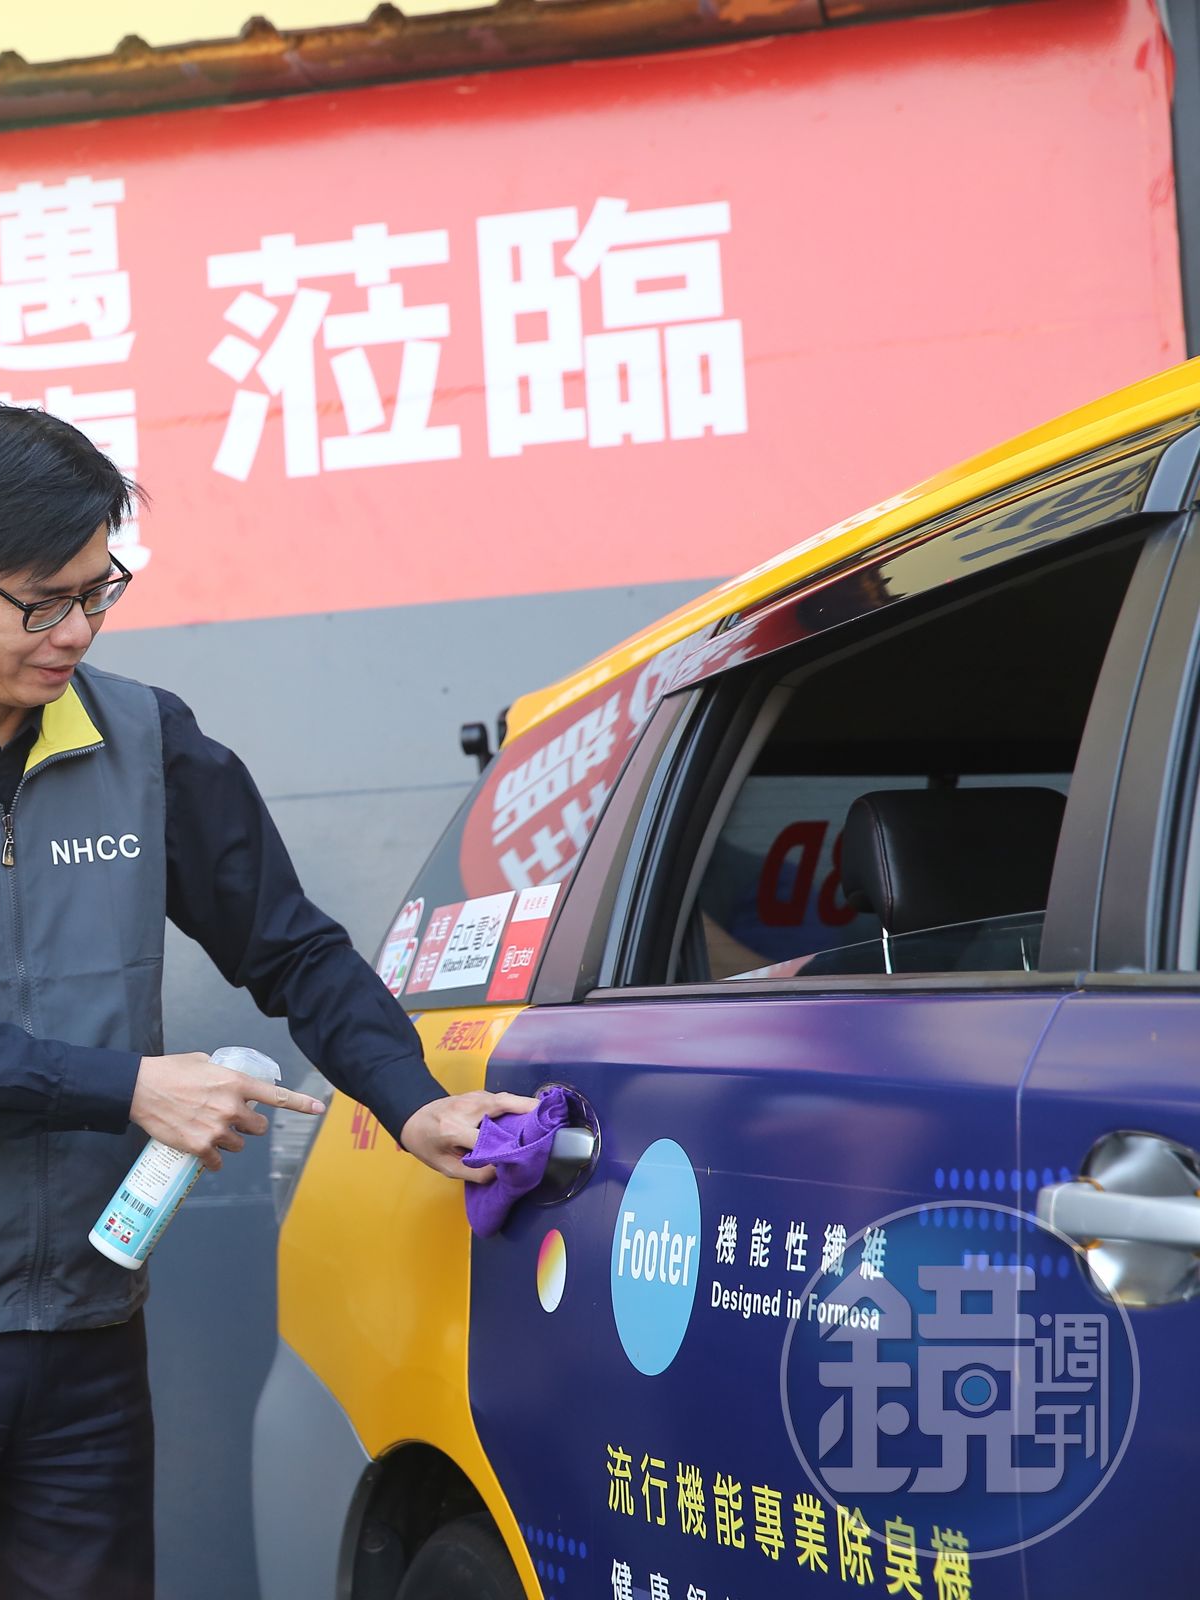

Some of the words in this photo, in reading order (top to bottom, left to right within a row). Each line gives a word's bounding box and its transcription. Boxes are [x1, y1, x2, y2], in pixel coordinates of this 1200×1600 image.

[207, 196, 749, 482] 蒞臨
[50, 833, 141, 865] NHCC
[617, 1211, 696, 1287] Footer
[715, 1214, 888, 1281] 機能性纖維
[711, 1280, 781, 1320] Designed
[786, 1290, 801, 1319] in
[807, 1293, 880, 1331] Formosa
